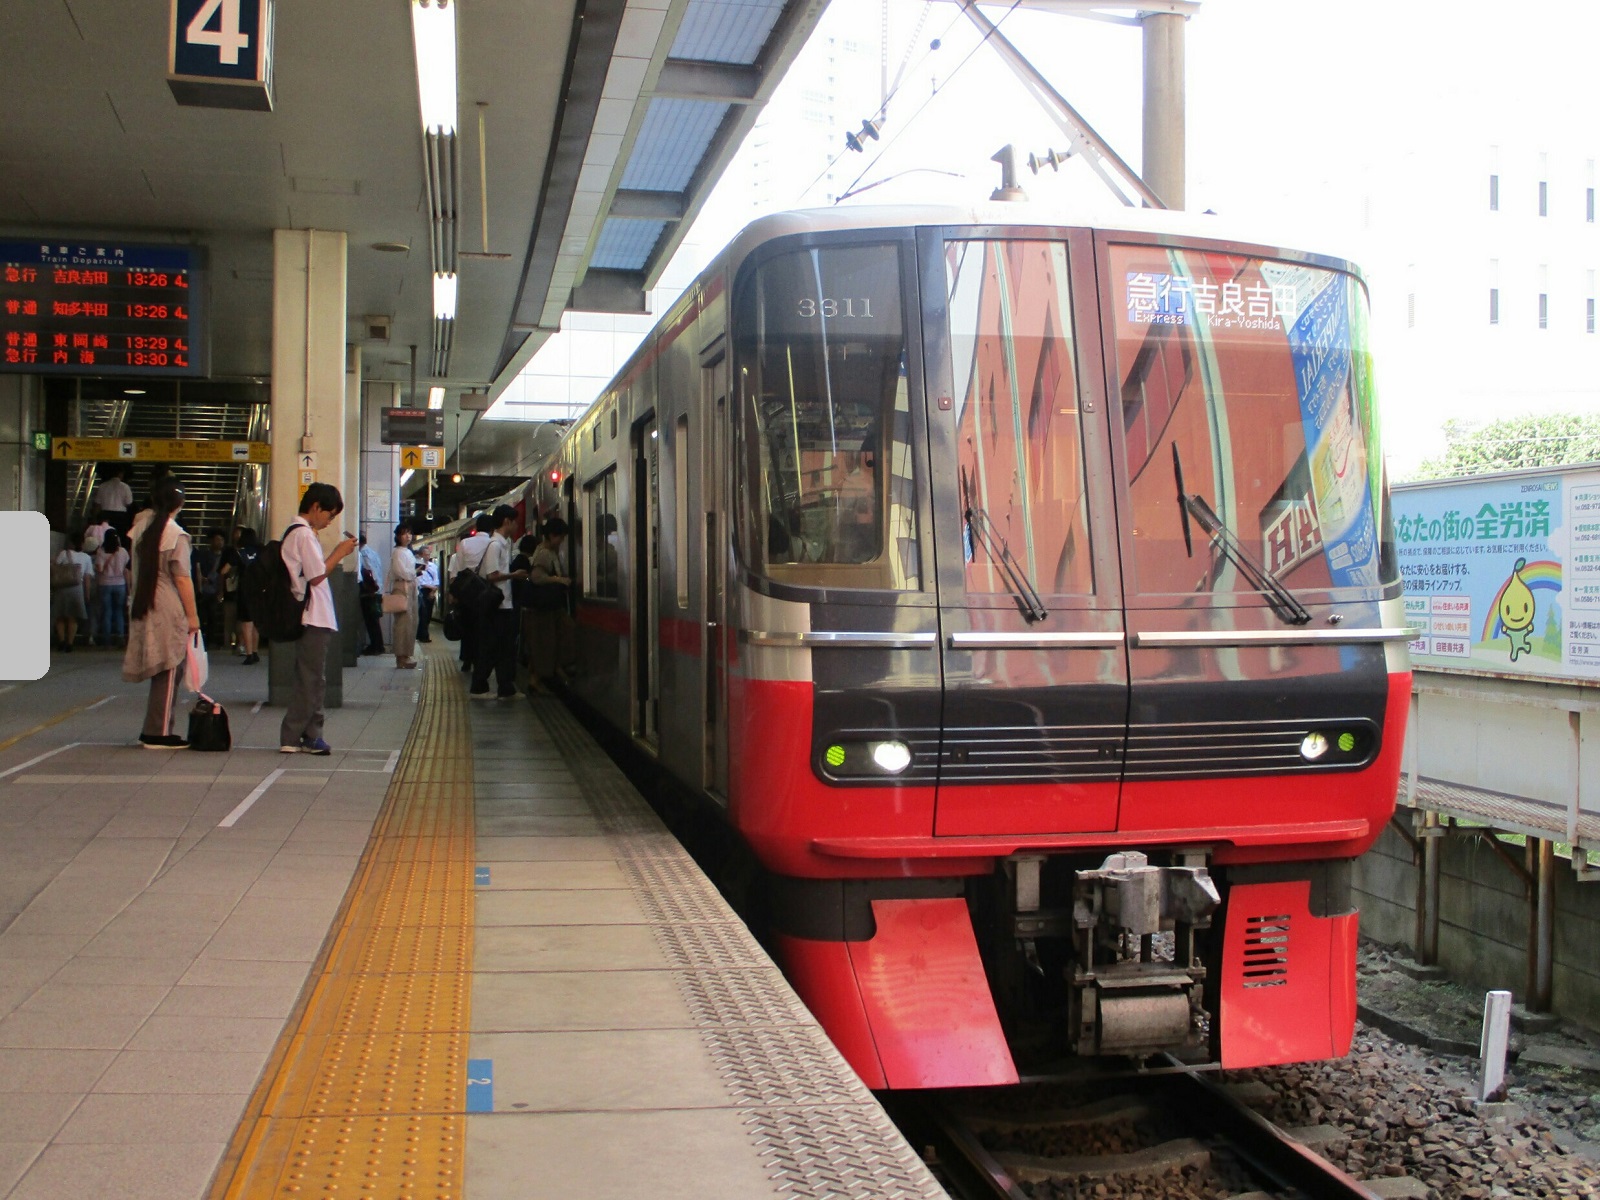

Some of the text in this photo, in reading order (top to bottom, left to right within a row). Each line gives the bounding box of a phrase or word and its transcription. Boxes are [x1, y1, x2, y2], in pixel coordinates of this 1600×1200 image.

[186, 0, 249, 65] 4
[41, 254, 124, 266] Train Departure
[5, 267, 37, 282] 急行
[53, 269, 108, 285] 吉良吉田
[127, 272, 167, 287] 13:26
[5, 299, 37, 315] 普通
[53, 301, 108, 316] 知多半田
[127, 304, 167, 319] 13:26
[1134, 311, 1281, 331] Express Kira-Yoshida
[5, 331, 37, 347] 普通
[127, 336, 167, 351] 13:29
[5, 348, 37, 363] 急行
[127, 352, 167, 367] 13:30
